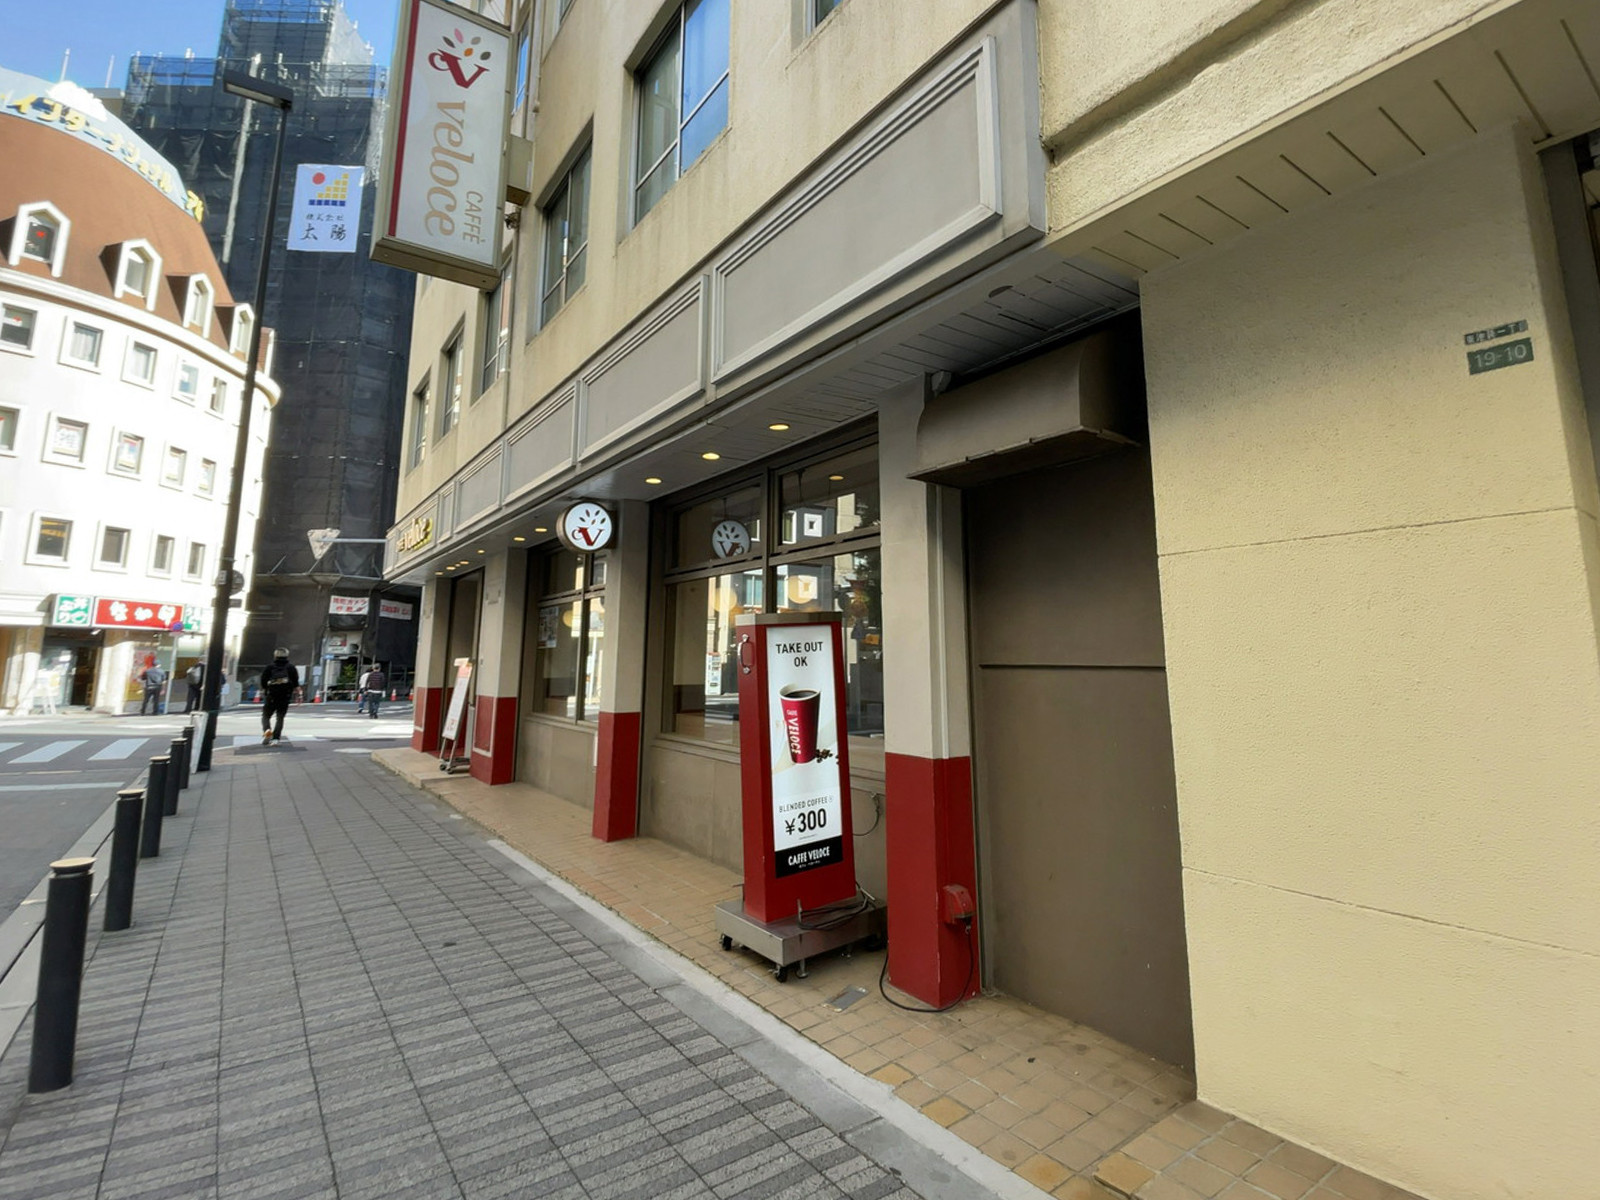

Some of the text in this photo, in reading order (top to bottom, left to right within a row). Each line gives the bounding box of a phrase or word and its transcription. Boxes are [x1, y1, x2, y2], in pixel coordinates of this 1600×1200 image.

[424, 100, 475, 237] veloce
[305, 213, 345, 222] 株式会社
[300, 223, 347, 241] 太陽
[1474, 344, 1527, 368] 19-10
[776, 641, 824, 654] TAKE OUT
[793, 656, 808, 668] OK
[778, 801, 806, 813] BLENDED
[806, 796, 828, 807] COFFEE
[784, 807, 827, 836] ¥300
[808, 846, 830, 861] VELOCE
